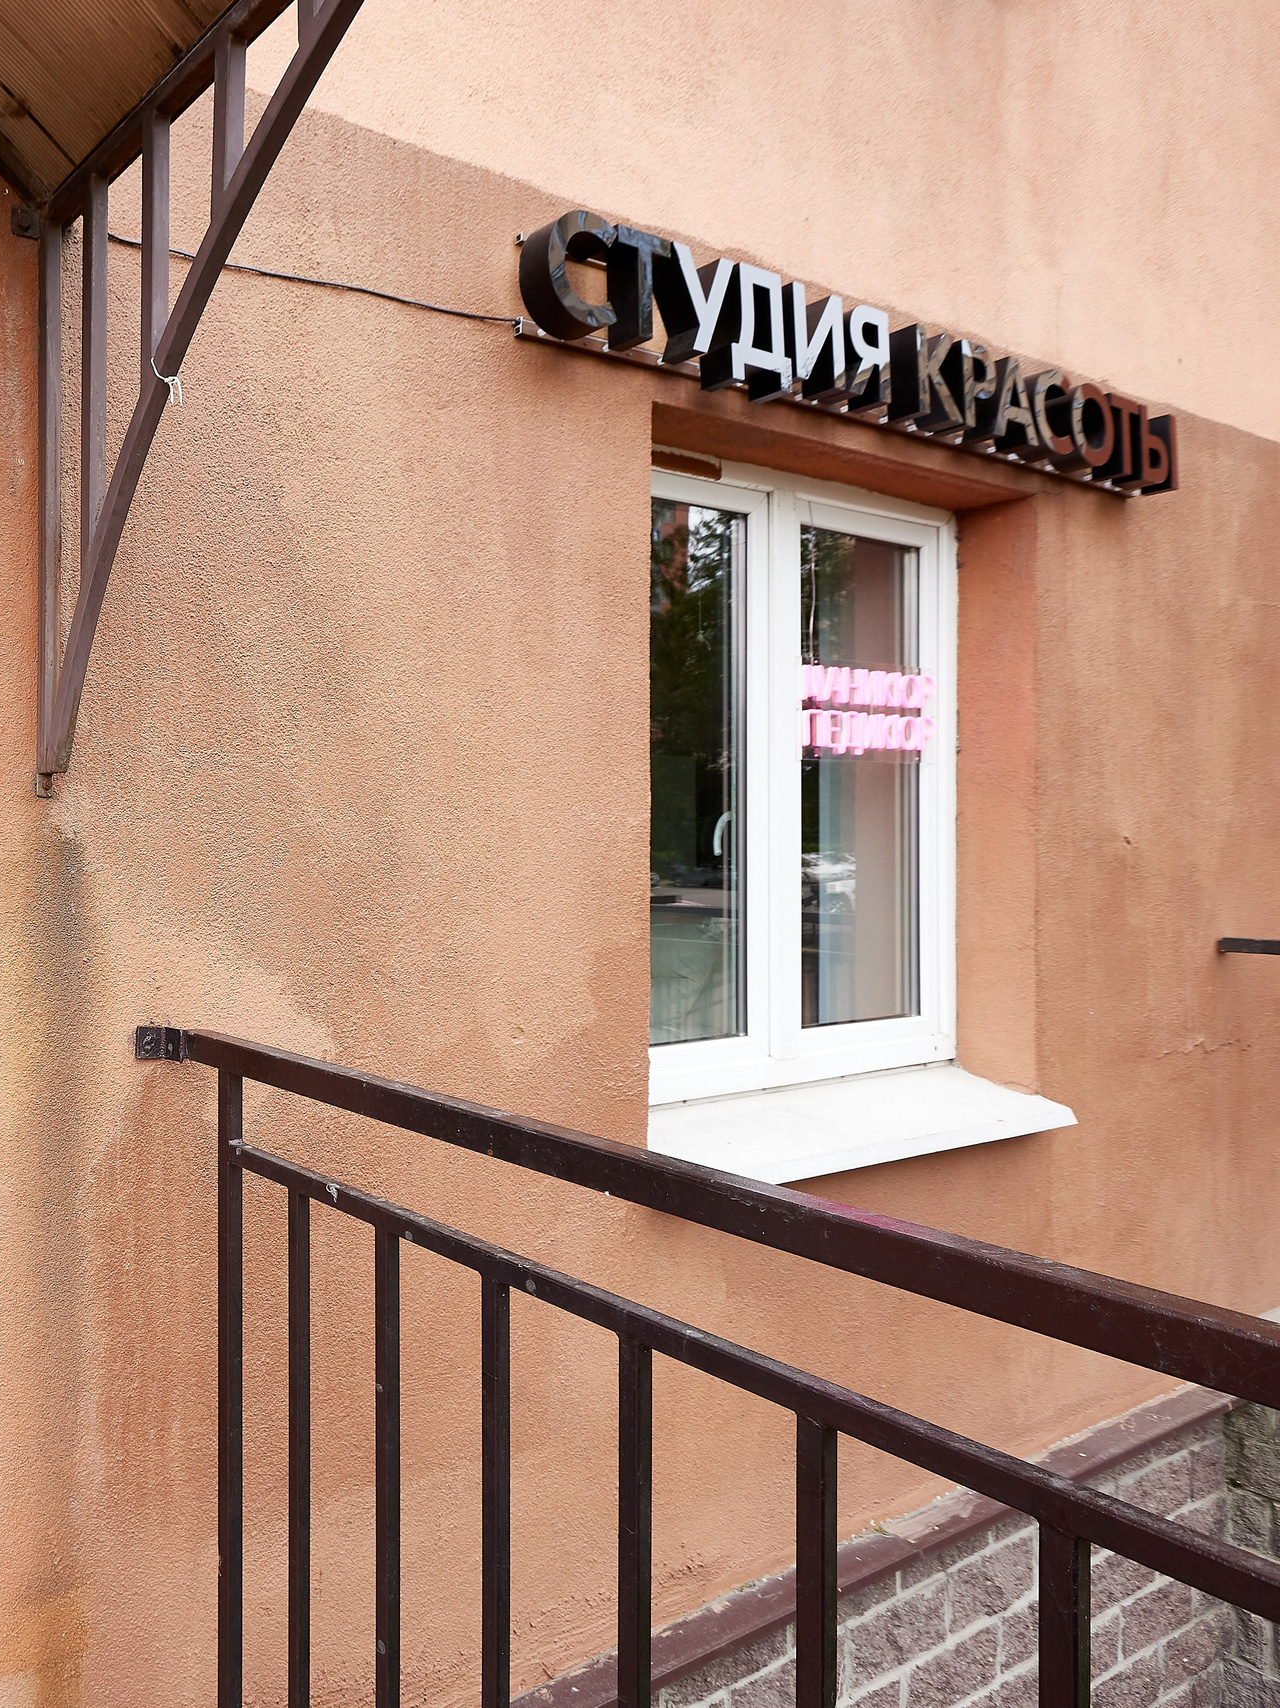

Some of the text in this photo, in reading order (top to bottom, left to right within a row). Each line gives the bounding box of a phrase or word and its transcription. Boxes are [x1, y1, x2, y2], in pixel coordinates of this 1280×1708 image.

[520, 210, 1178, 496] СТУДИЯ КРАСОТЫ
[802, 664, 937, 708] МАНИКЮР
[802, 709, 937, 755] ПЕДИКЮР
